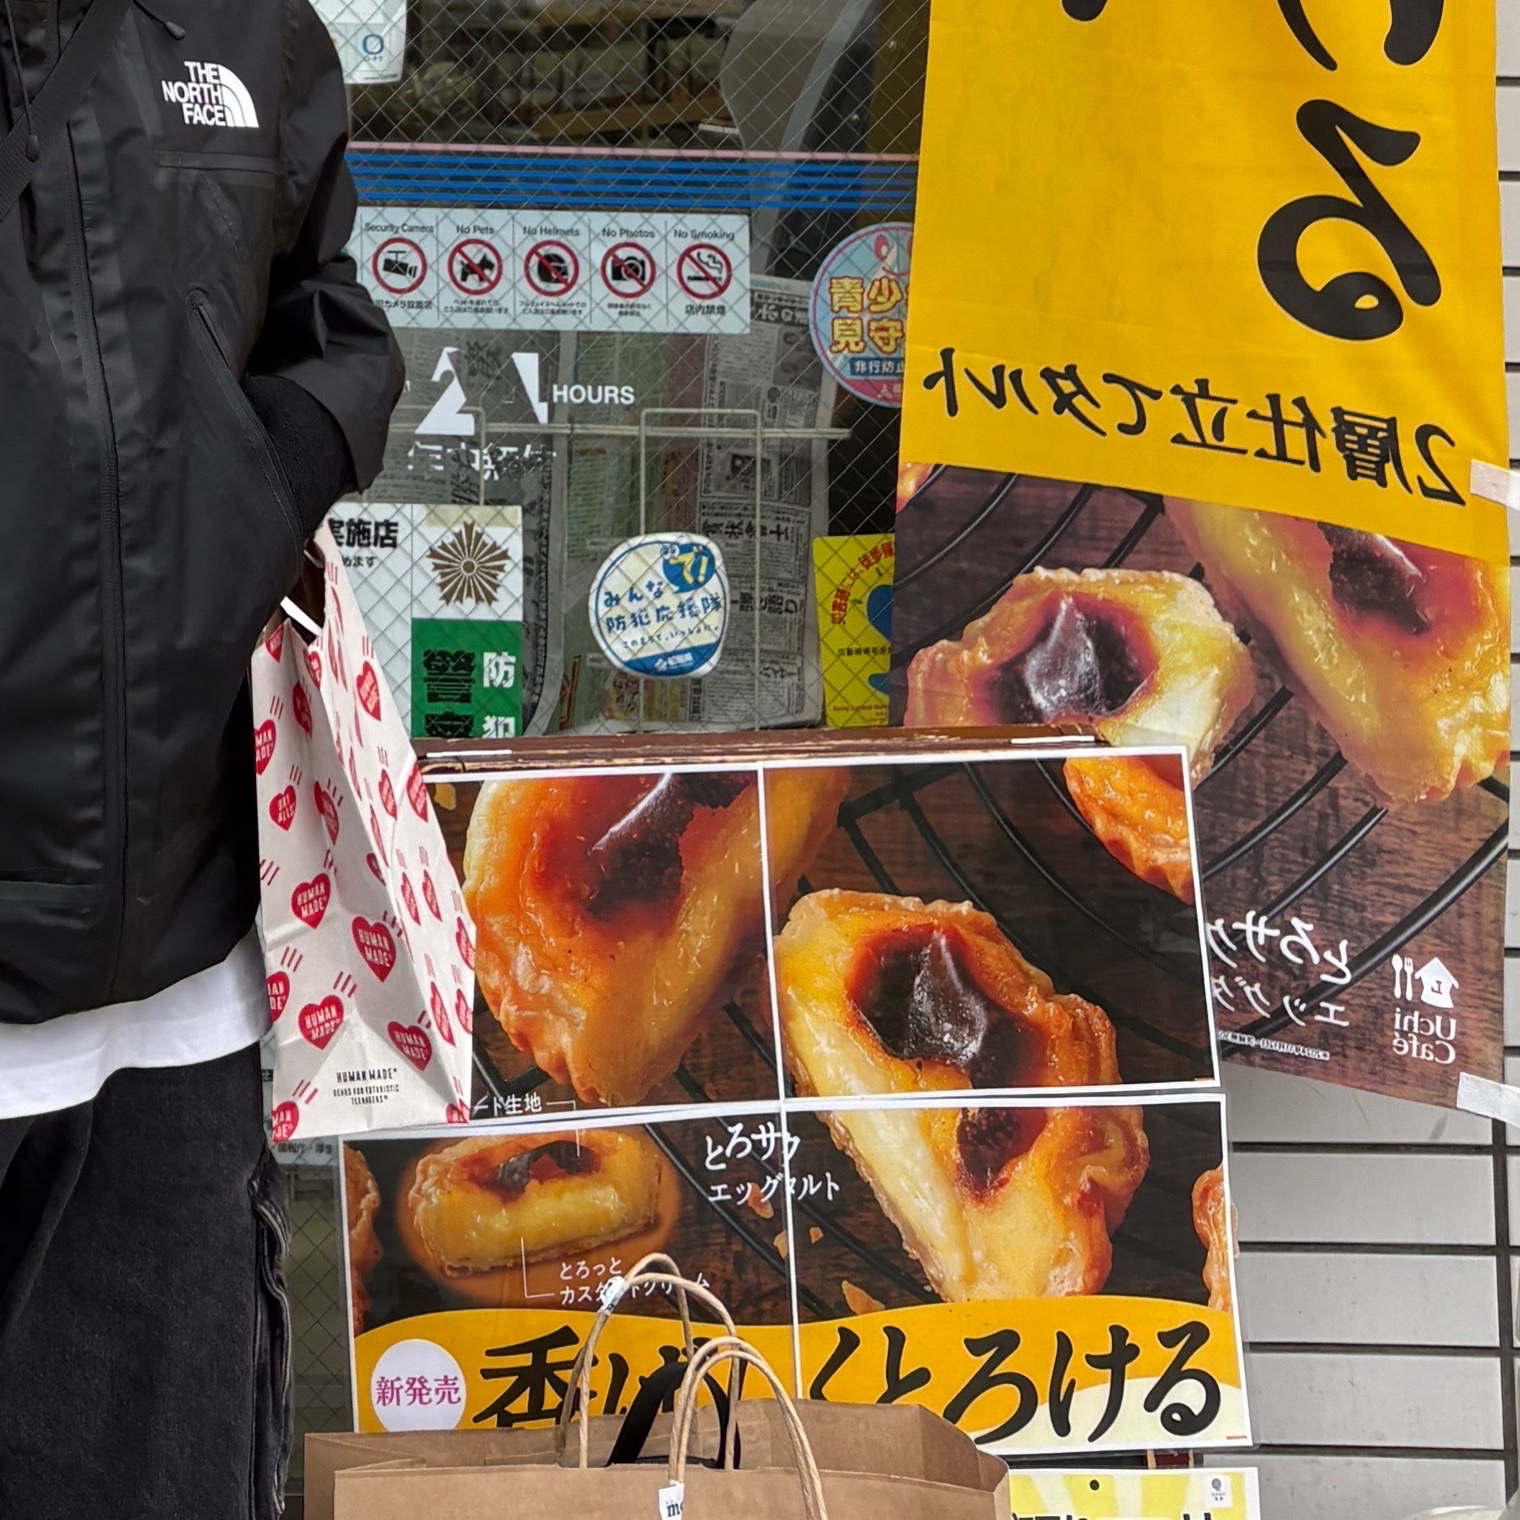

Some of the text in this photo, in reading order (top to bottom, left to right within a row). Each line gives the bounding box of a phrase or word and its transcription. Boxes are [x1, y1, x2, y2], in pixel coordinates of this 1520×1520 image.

[184, 61, 219, 84] THE
[162, 80, 222, 104] NORTH
[184, 104, 228, 127] FACE
[364, 223, 435, 235] Security Camera
[456, 225, 495, 235] No Pets
[523, 226, 580, 237] No Helmets
[602, 228, 655, 239] No Photos
[674, 230, 736, 241] No Smoking
[829, 275, 909, 314] 青少
[684, 304, 726, 316] 店内禁煙
[552, 384, 635, 405] HOURS
[604, 581, 664, 608] みんな
[605, 593, 722, 633] 防犯応援隊
[298, 882, 326, 904] HUMAN
[357, 930, 390, 952] HUMAN
[304, 1004, 338, 1027] HUMAN
[394, 1030, 426, 1049] HUMAN
[336, 1070, 367, 1083] HUMAN
[704, 1122, 801, 1171] とろサク
[559, 1256, 622, 1279] とろっと
[375, 1375, 462, 1408] 新発売
